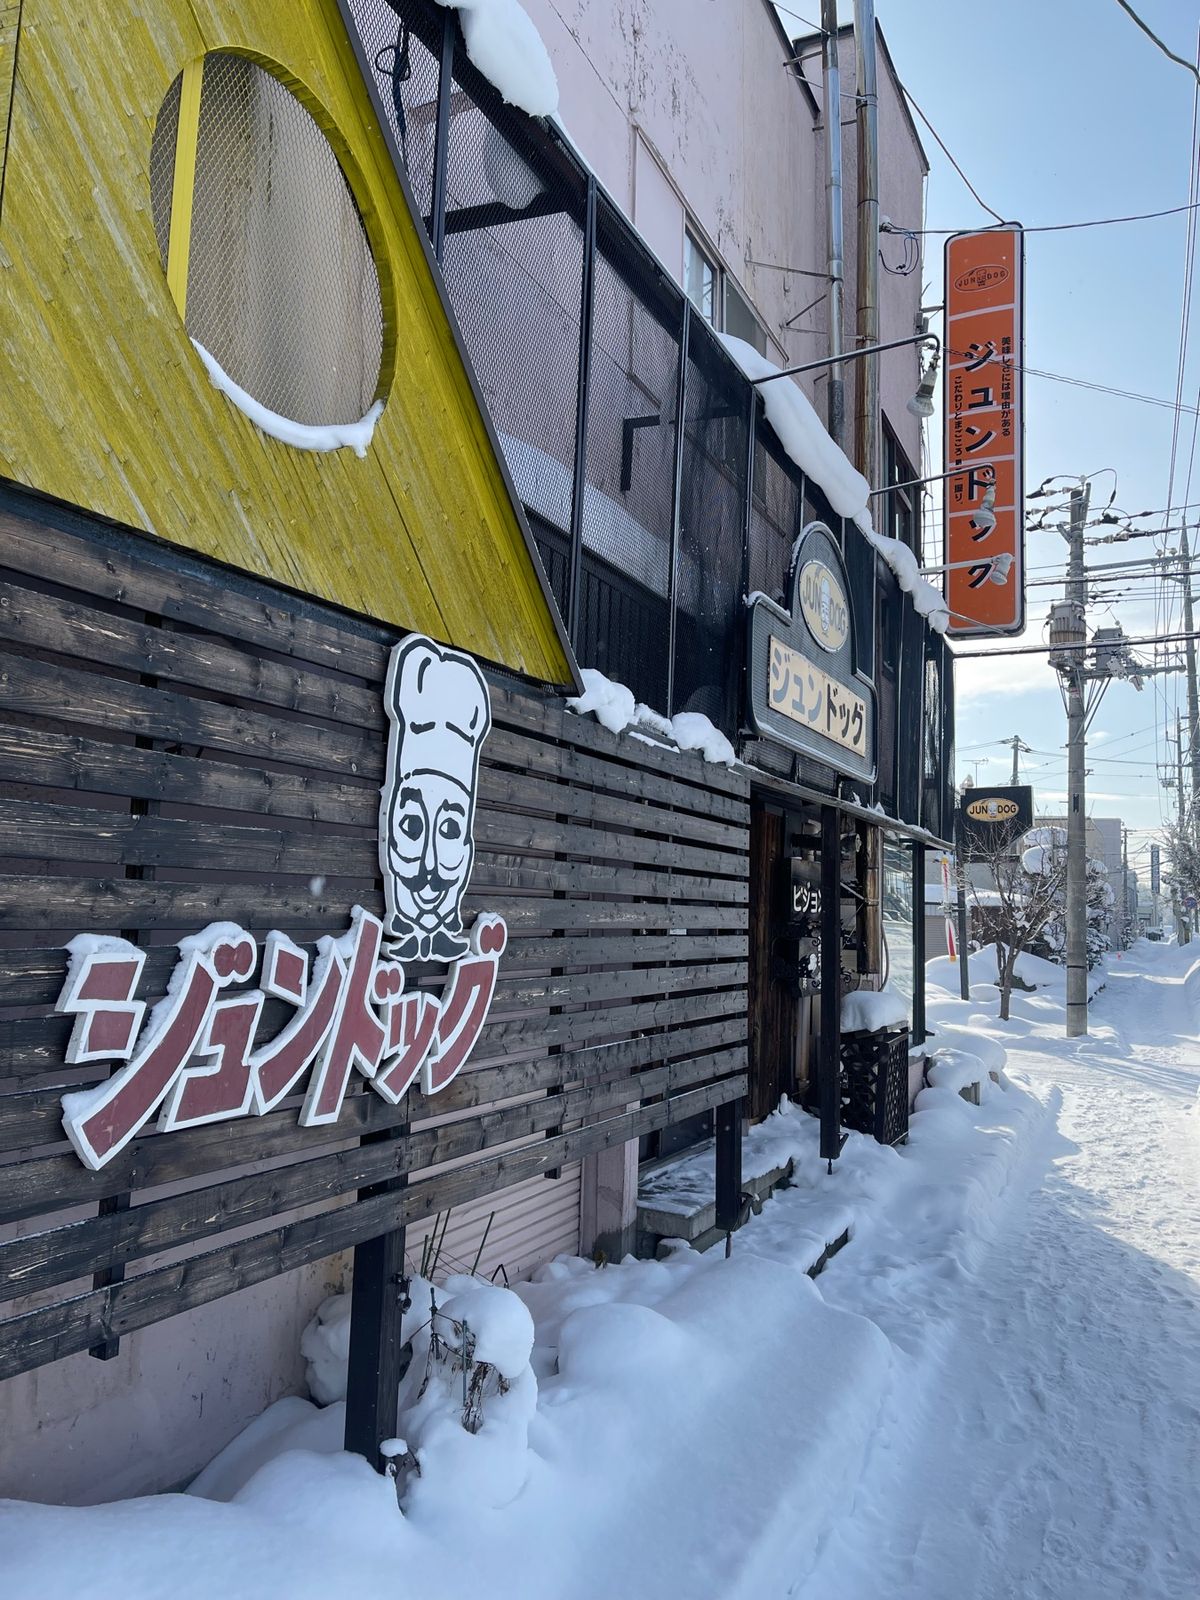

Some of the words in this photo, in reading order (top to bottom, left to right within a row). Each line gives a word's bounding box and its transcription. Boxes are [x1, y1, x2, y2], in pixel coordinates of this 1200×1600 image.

[958, 277, 976, 287] JUN
[803, 574, 821, 617] JUN
[829, 597, 845, 637] DOG
[771, 647, 864, 746] ジュンドッグ
[969, 804, 988, 815] JUN
[997, 804, 1017, 814] DOG
[56, 907, 508, 1171] ジュンドッグ
